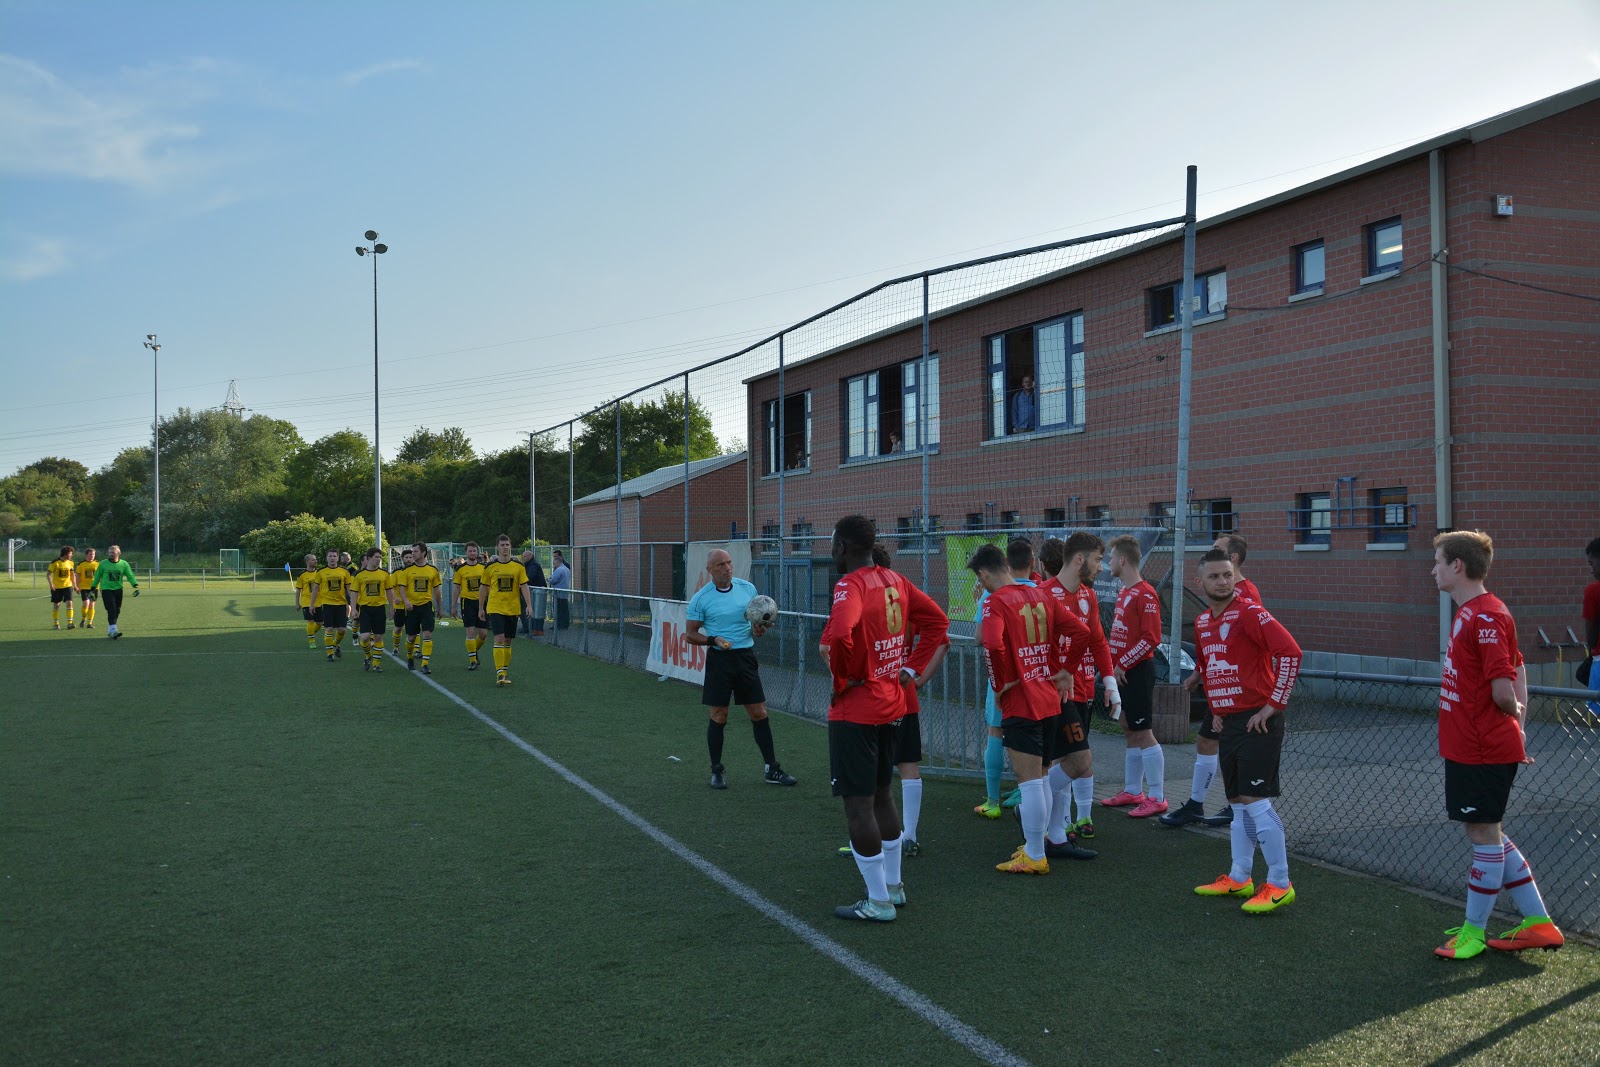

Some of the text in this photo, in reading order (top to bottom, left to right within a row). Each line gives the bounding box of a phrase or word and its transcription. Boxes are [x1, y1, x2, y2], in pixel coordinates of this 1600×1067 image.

[884, 586, 902, 634] 6
[1018, 602, 1047, 644] 11
[1478, 628, 1497, 638] XYZ
[1120, 655, 1130, 664] ALL
[1128, 639, 1148, 656] PALLETS
[1270, 656, 1290, 702] ALL PALLETS
[1064, 721, 1085, 744] 15
